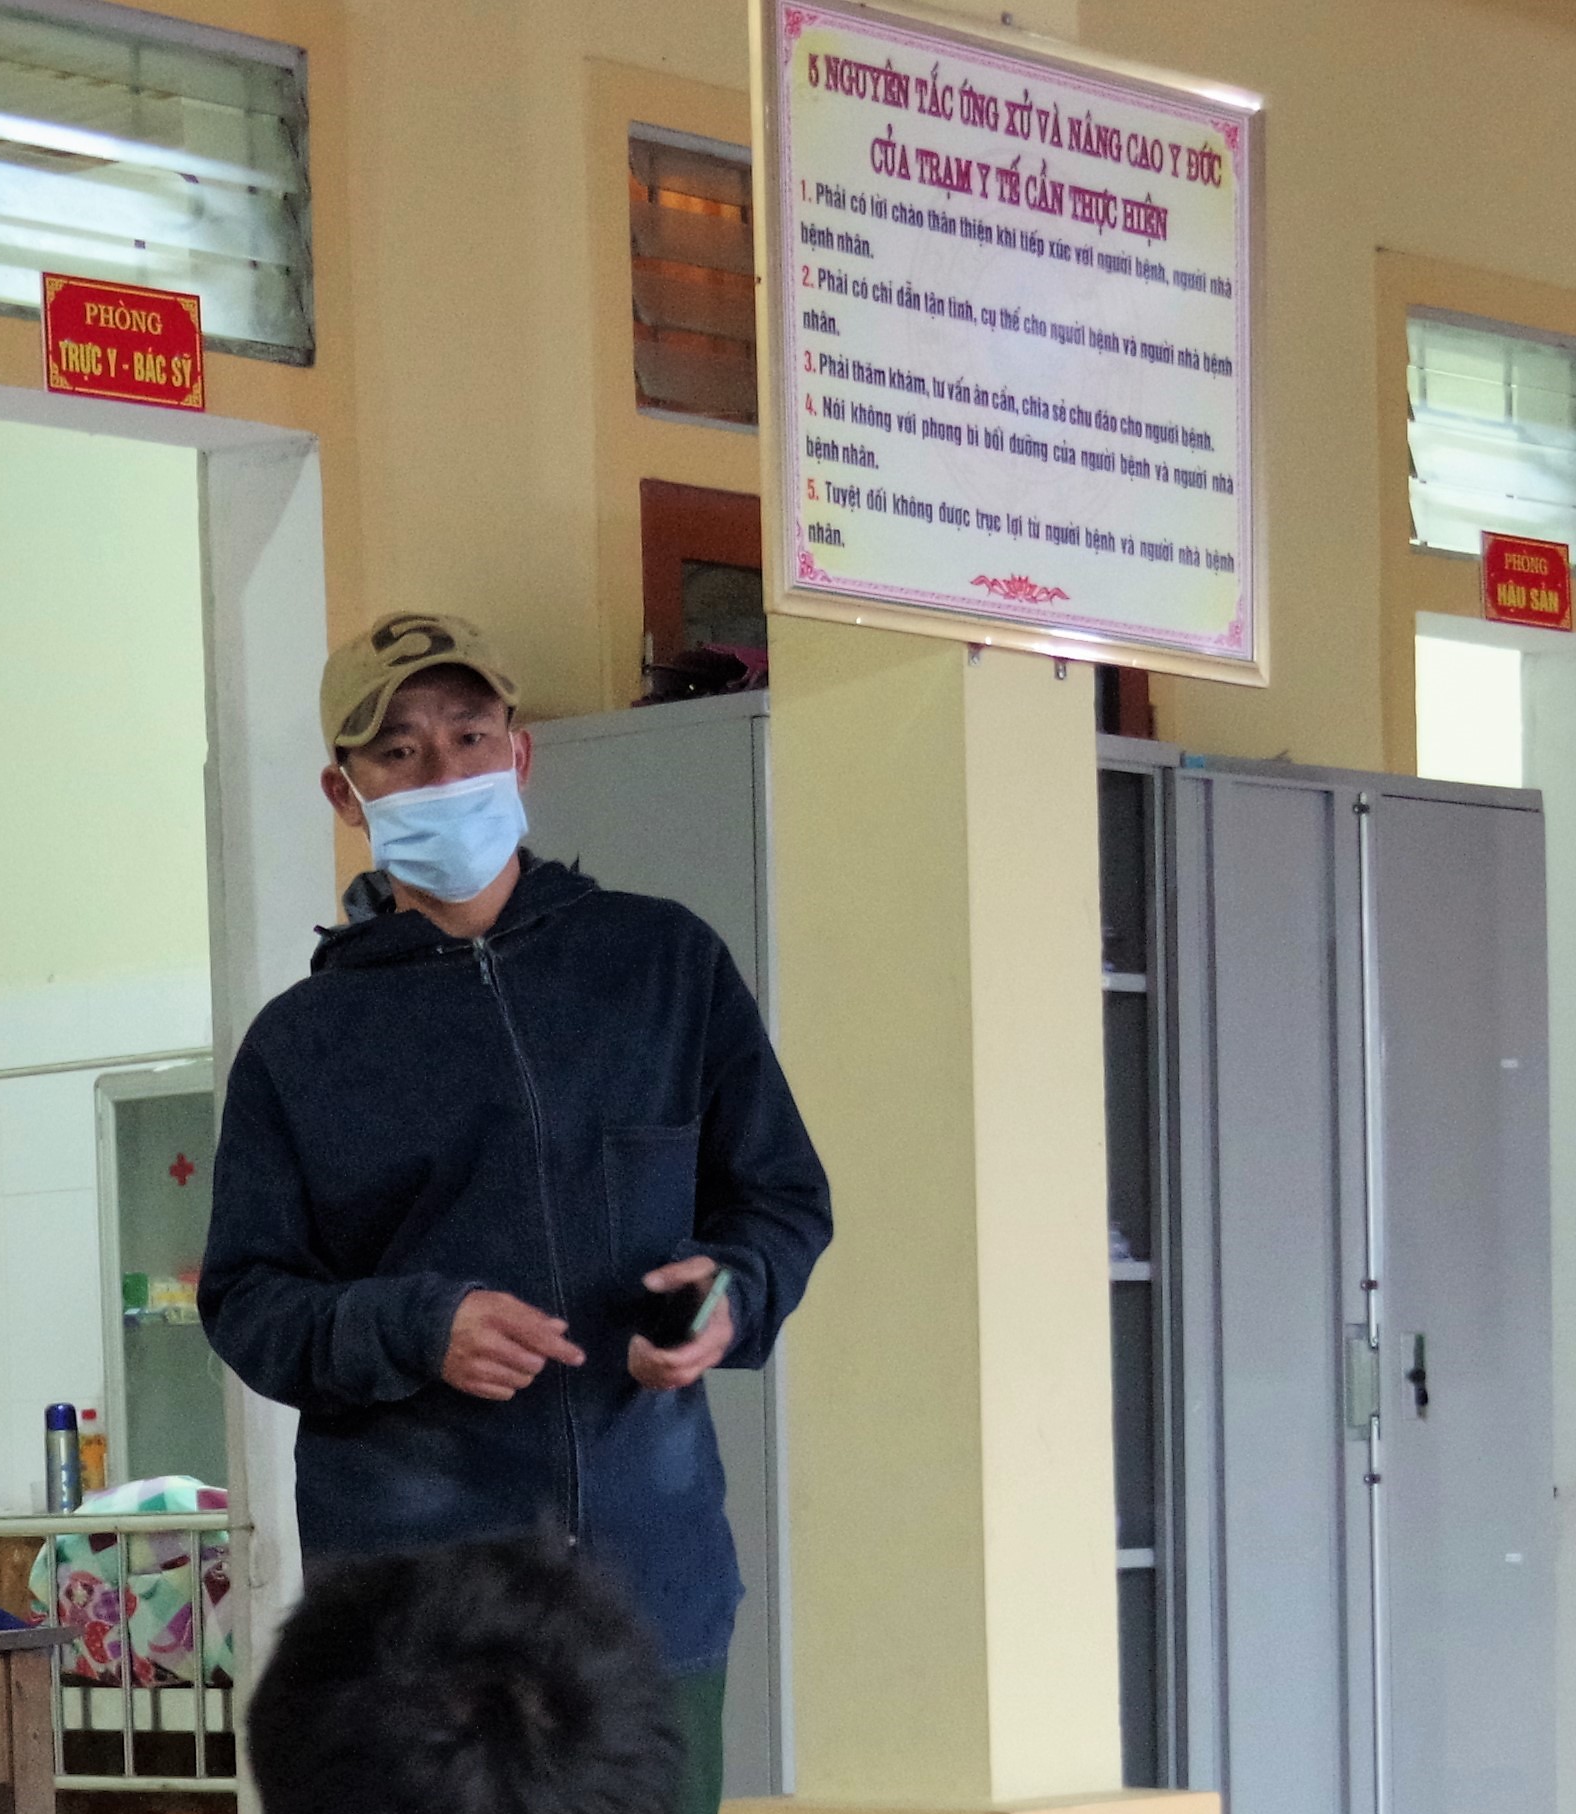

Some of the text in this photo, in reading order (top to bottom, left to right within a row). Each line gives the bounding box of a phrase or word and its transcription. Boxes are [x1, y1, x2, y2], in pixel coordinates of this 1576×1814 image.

[808, 53, 1222, 188] 5 NGUYÊN TẮC ỨNG XỬ VÀ NÂNG CAO Y ĐỨC
[801, 179, 812, 203] 1.
[816, 182, 846, 211] Phải
[850, 193, 867, 215] có
[871, 193, 887, 219] lời
[891, 203, 924, 228] chào
[927, 208, 956, 235] thân
[960, 215, 993, 247] thiện
[996, 224, 1016, 249] khi
[1020, 230, 1045, 258] tiếp
[871, 123, 1168, 248] CỦA TRẠM Y TẾ CẦN THỰC HIỆN
[801, 221, 874, 259] bệnh nhân.
[84, 300, 163, 335] PHÒNG
[802, 265, 814, 288] 2.
[818, 268, 847, 296] Phải
[852, 277, 868, 300] có
[897, 281, 921, 311] dẫn
[924, 292, 945, 319] tận
[981, 307, 996, 332] cụ
[1024, 314, 1046, 337] cho
[59, 340, 103, 382] TRỰC
[107, 347, 117, 378] Y
[133, 347, 167, 386] BÁC
[171, 352, 194, 388] SỸ
[804, 350, 816, 373] 3.
[819, 353, 849, 381] Phải
[933, 376, 945, 399] tư
[948, 376, 970, 403] vấn
[1022, 396, 1049, 420] chia
[1069, 404, 1092, 428] chu
[1095, 409, 1117, 433] đáo
[1120, 414, 1142, 438] cho
[805, 393, 817, 416] 4.
[823, 396, 845, 421] Nói
[851, 402, 892, 433] không
[897, 411, 916, 435] với
[922, 417, 961, 446] phong
[967, 424, 979, 447] bì
[1053, 439, 1076, 465] của
[1121, 453, 1150, 481] bệnh
[1155, 460, 1169, 483] và
[1212, 472, 1234, 495] nhà
[806, 436, 879, 470] bệnh nhân.
[807, 478, 819, 501] 5.
[825, 481, 861, 512] Tuyệt
[867, 487, 887, 513] đối
[893, 493, 933, 524] không
[939, 502, 970, 531] được
[976, 508, 1001, 536] trục
[1007, 513, 1022, 540] lợi
[1085, 527, 1115, 554] bệnh
[1121, 534, 1135, 556] và
[1179, 546, 1200, 568] nhà
[1206, 549, 1234, 575] bệnh
[1505, 549, 1548, 576] PHÒNG
